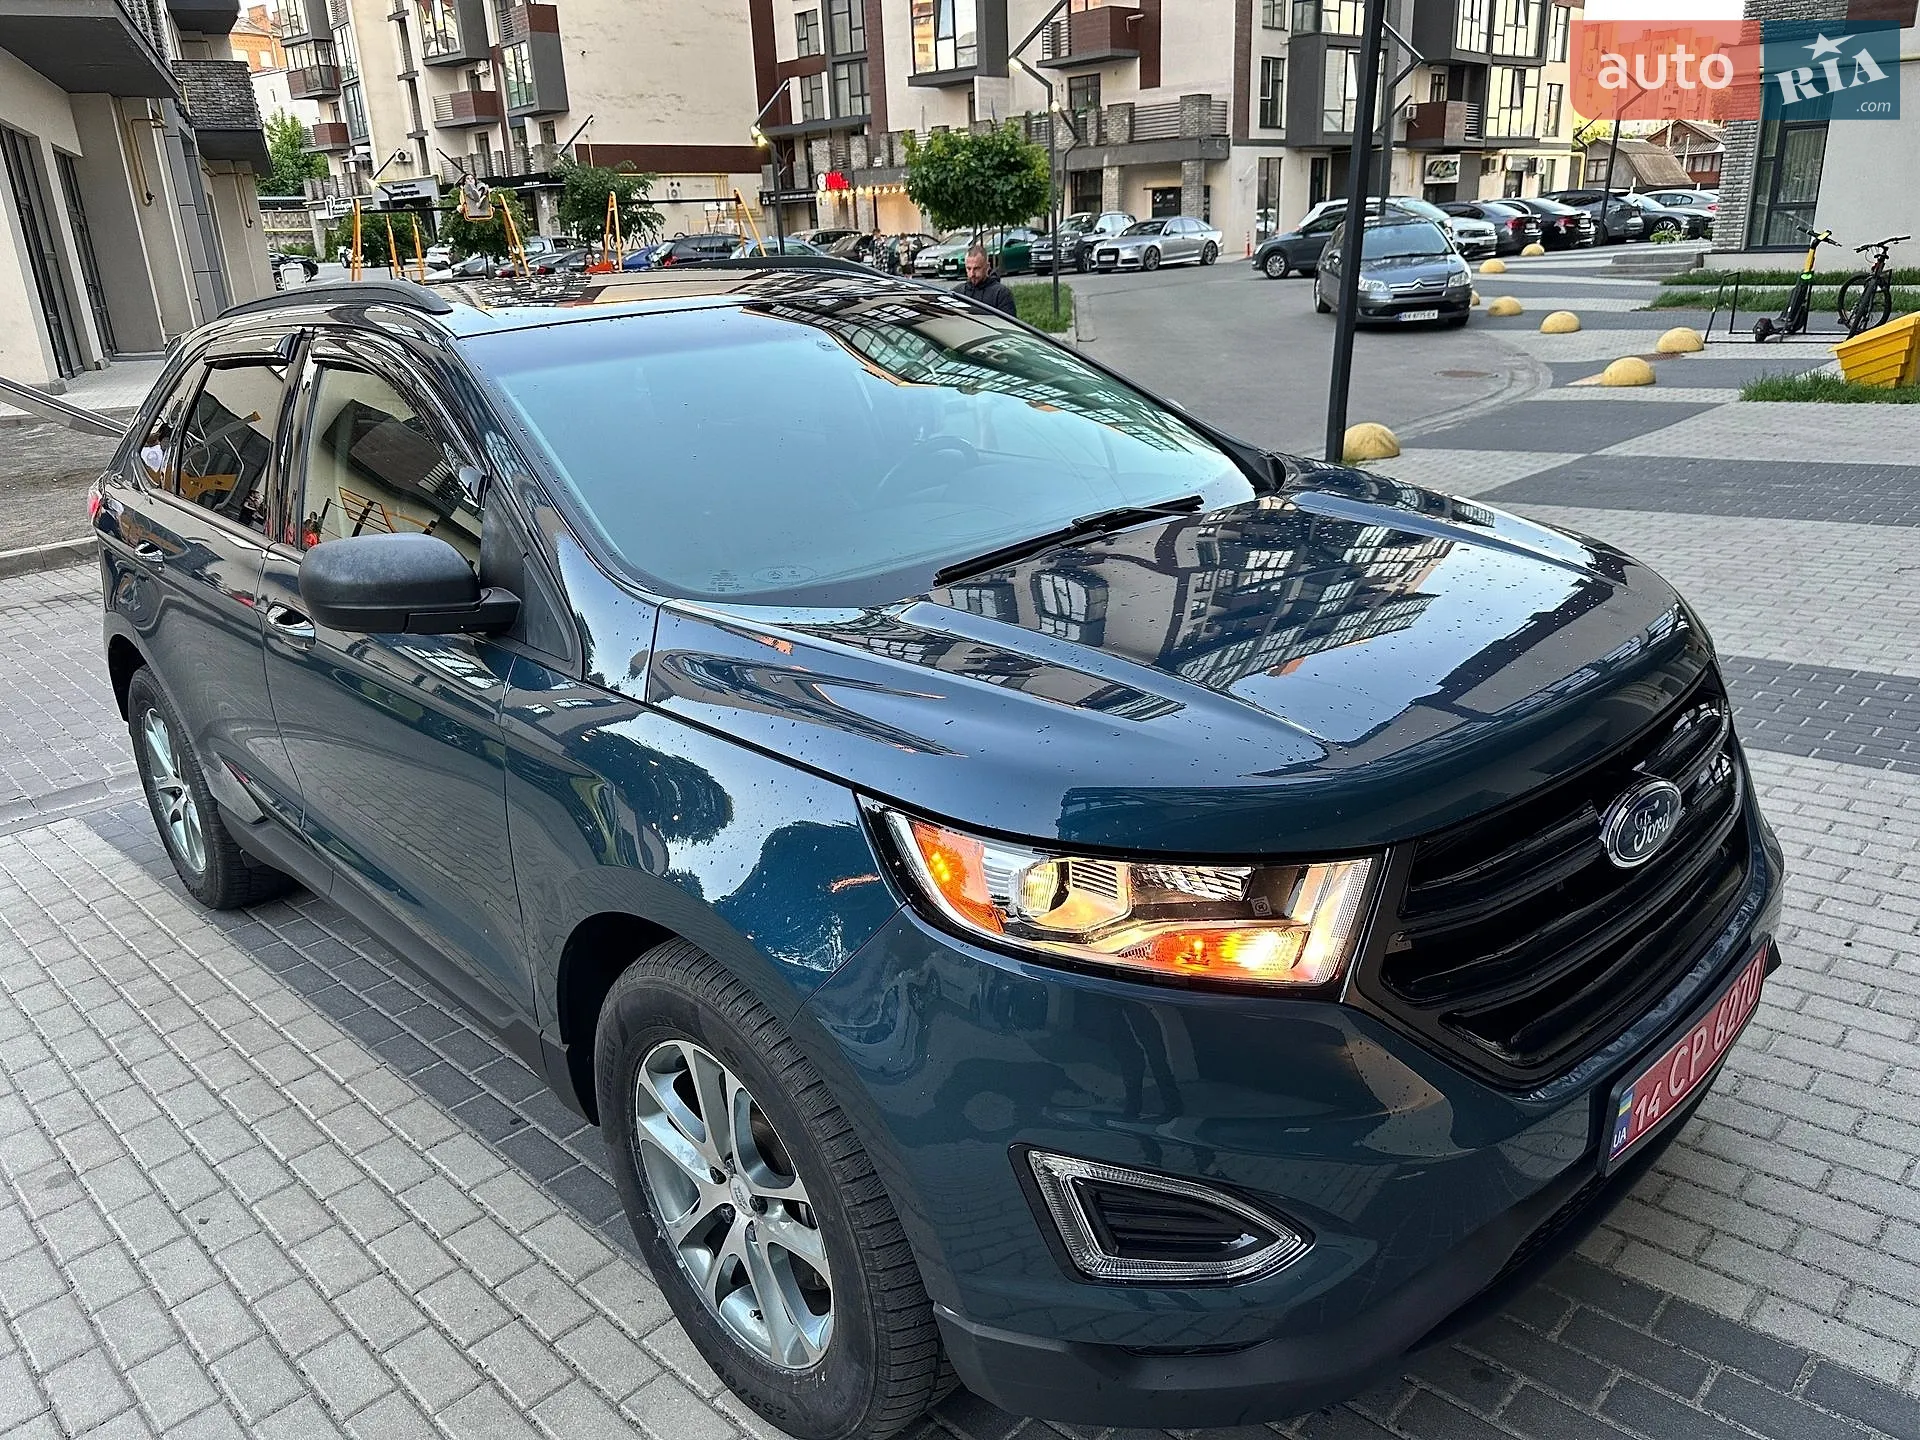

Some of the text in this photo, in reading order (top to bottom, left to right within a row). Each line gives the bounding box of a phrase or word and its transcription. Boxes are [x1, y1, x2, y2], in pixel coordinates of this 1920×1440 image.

[1633, 799, 1671, 852] Ford
[1634, 959, 1760, 1131] 14 CP 6270
[1613, 1127, 1627, 1148] UA
